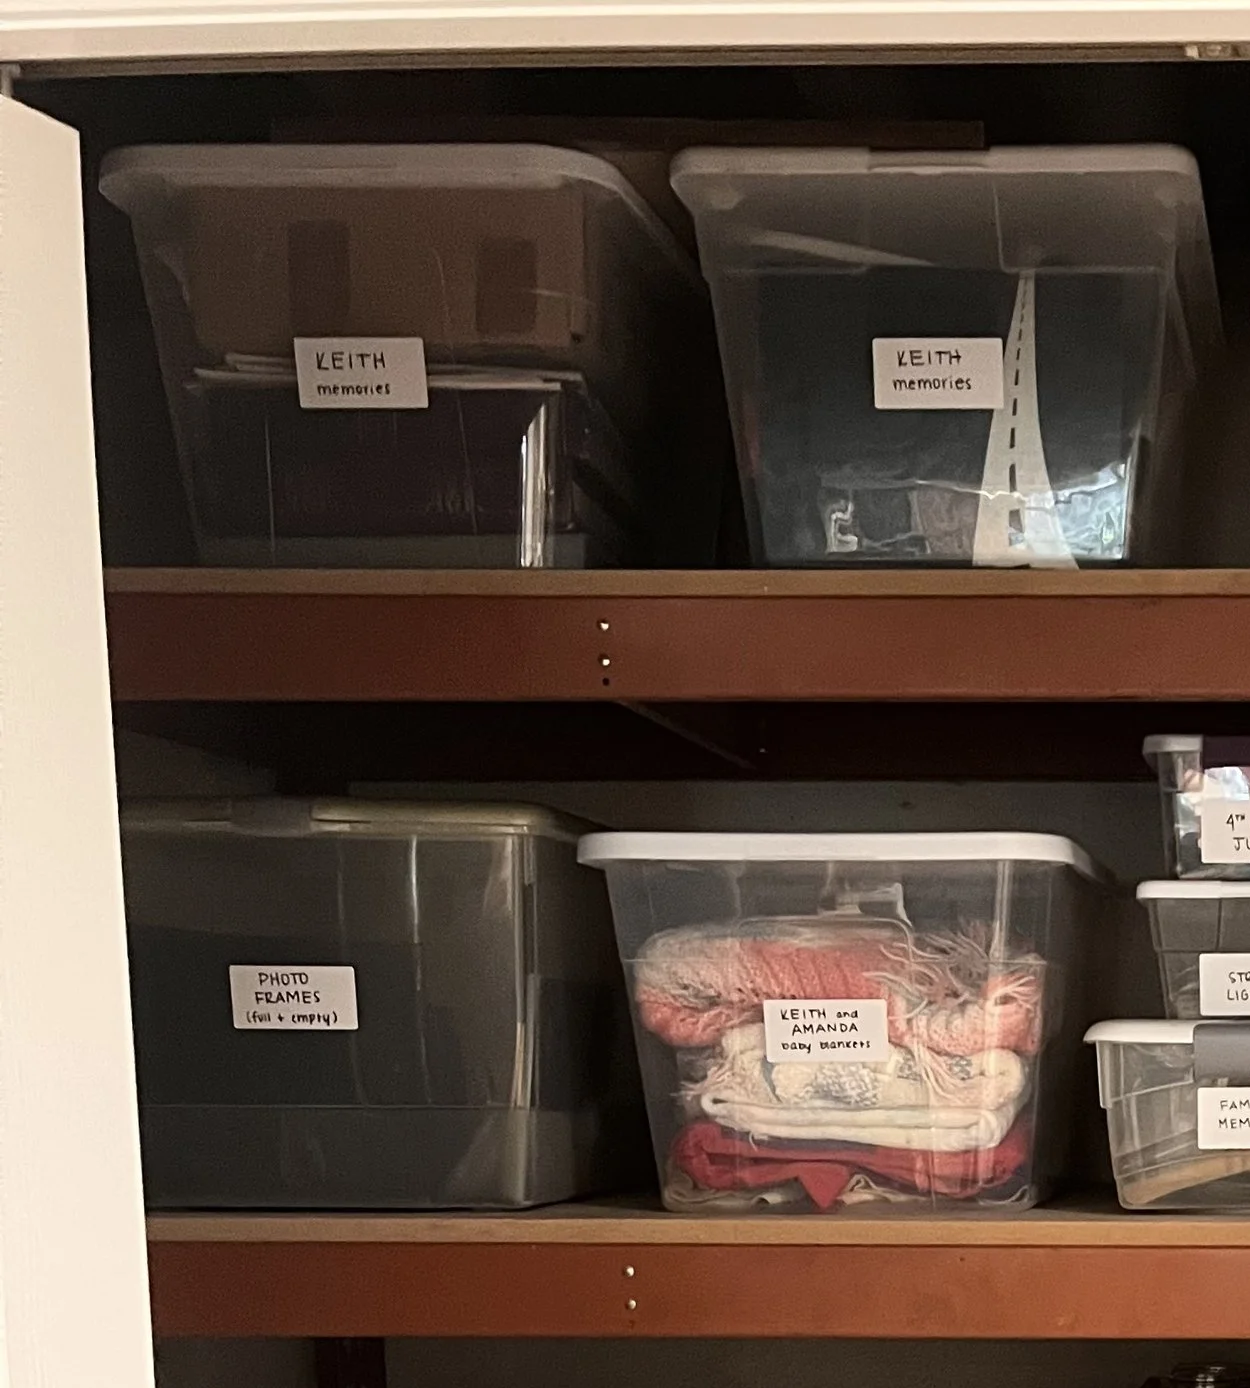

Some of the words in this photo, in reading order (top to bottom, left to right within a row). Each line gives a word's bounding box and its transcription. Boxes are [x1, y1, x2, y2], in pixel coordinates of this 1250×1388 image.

[316, 351, 386, 370] KEITH
[897, 350, 962, 367] KEITH
[317, 383, 390, 395] memories
[893, 377, 972, 390] memories
[258, 973, 309, 985] PHOTO
[255, 991, 320, 1004] FRAMES
[780, 1009, 827, 1020] KEITH
[837, 1010, 858, 1018] and
[792, 1023, 858, 1035] AMANDA
[781, 1041, 811, 1053] baby
[820, 1039, 871, 1050] blankets
